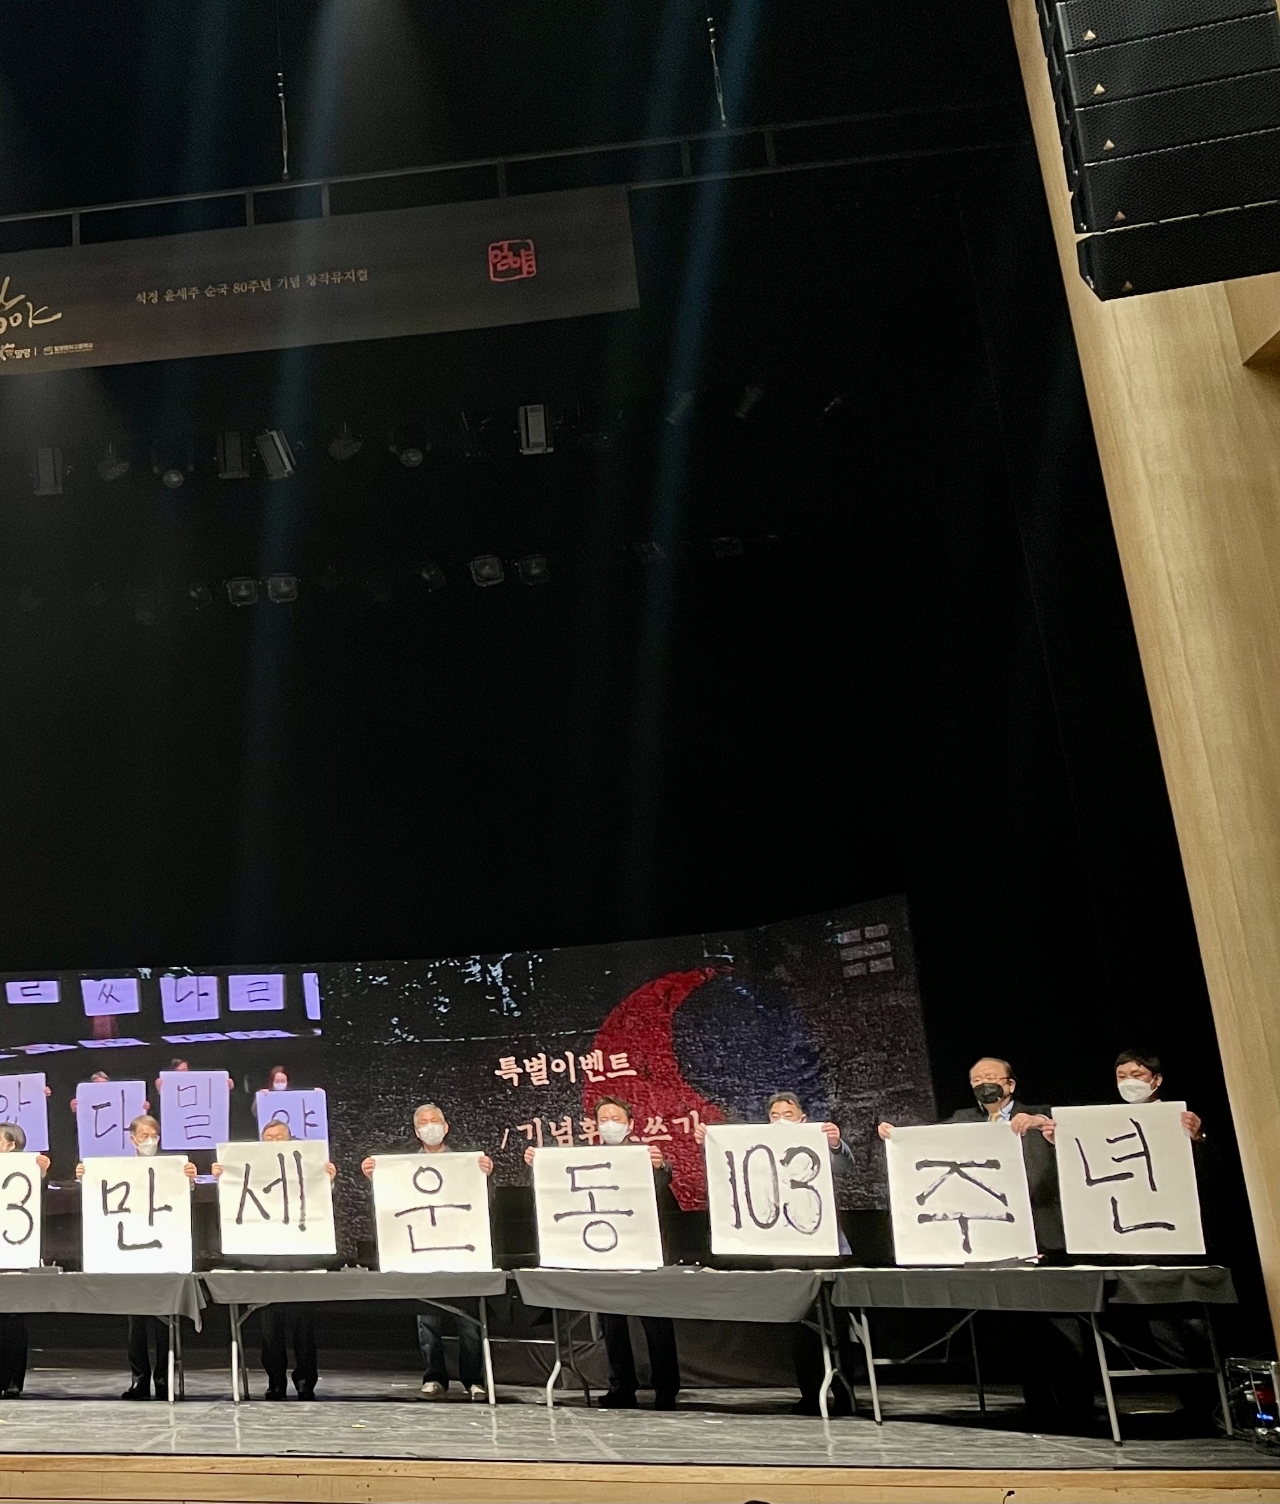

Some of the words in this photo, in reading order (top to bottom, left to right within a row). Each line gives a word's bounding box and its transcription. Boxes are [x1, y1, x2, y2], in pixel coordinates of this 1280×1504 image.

[135, 290, 159, 305] 석정
[163, 286, 201, 302] 윤세주
[204, 282, 230, 298] 순국
[232, 278, 272, 294] 80주년
[277, 275, 301, 290] 기념
[305, 268, 369, 288] 창작뮤지컬
[177, 1077, 213, 1140] 밀
[494, 1049, 638, 1087] 특별이벤트
[101, 1166, 173, 1252] 만
[234, 1149, 307, 1232] 세
[394, 1165, 476, 1254] 운
[553, 1161, 635, 1254] 동
[724, 1143, 823, 1236] 103
[914, 1158, 1016, 1255] 주
[1073, 1116, 1178, 1236] 년
